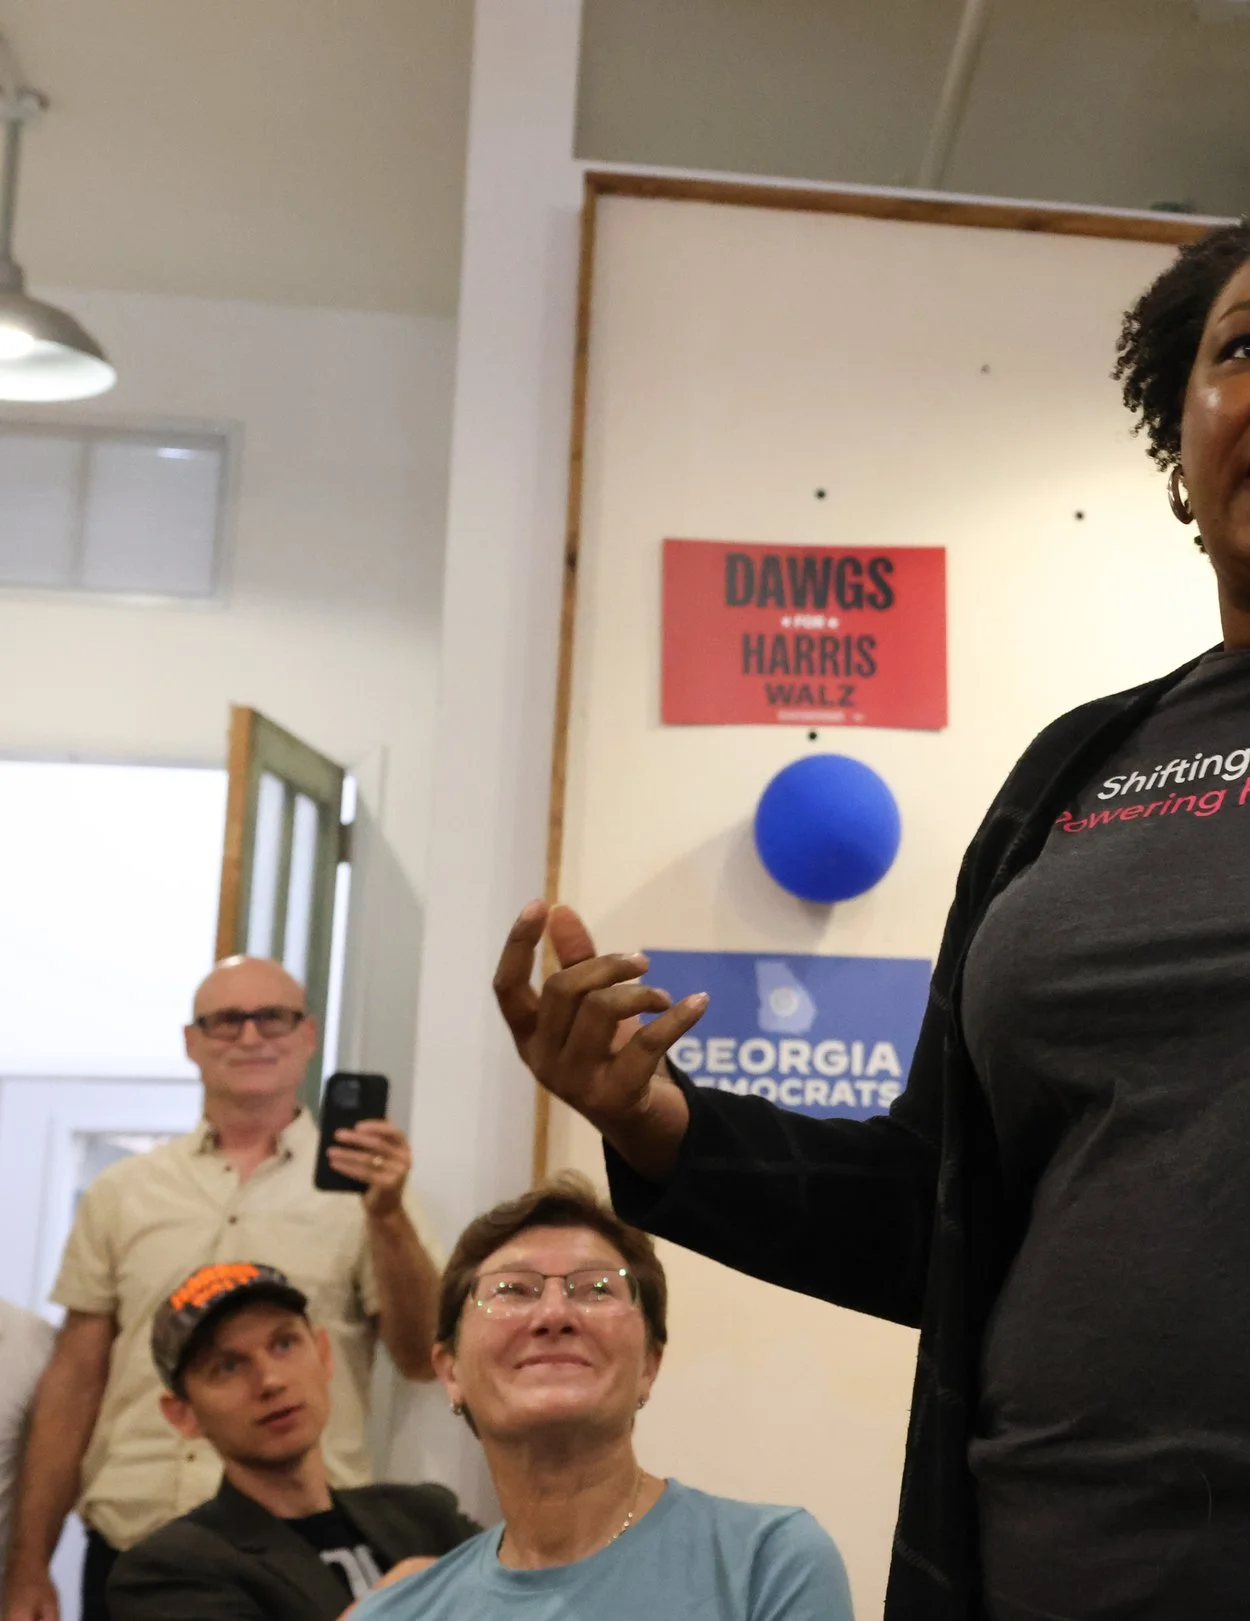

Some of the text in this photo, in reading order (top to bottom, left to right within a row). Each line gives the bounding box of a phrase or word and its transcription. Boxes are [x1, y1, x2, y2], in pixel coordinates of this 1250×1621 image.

[724, 552, 896, 612] DAWGS
[742, 633, 877, 679] HARRIS
[764, 682, 856, 708] WALZ
[667, 1036, 902, 1077] GEORGIA
[693, 1076, 902, 1109] MOCRATS
